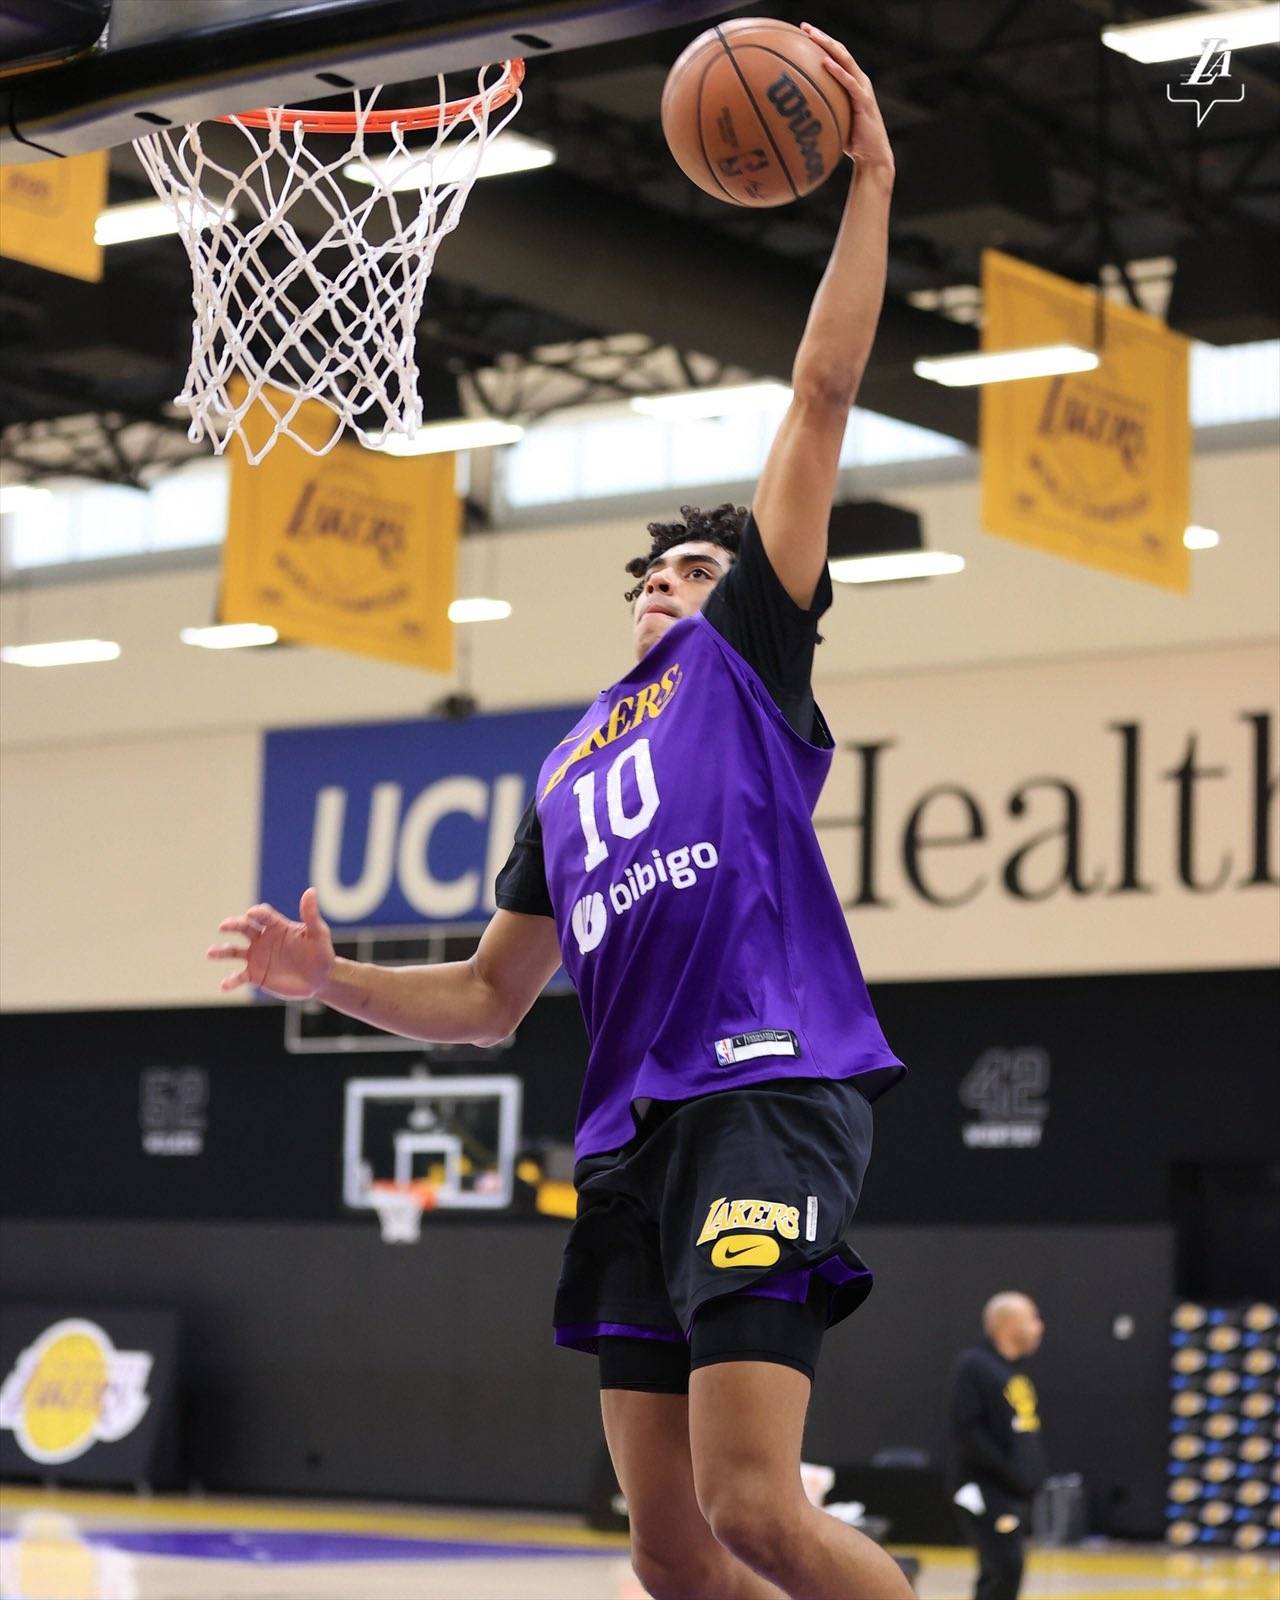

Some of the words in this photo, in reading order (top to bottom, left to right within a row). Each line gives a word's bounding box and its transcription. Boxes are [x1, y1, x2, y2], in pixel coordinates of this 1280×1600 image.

[573, 738, 660, 873] 10
[609, 841, 719, 915] bibigo
[959, 1046, 1051, 1121] 42
[696, 1197, 800, 1246] LAKERS
